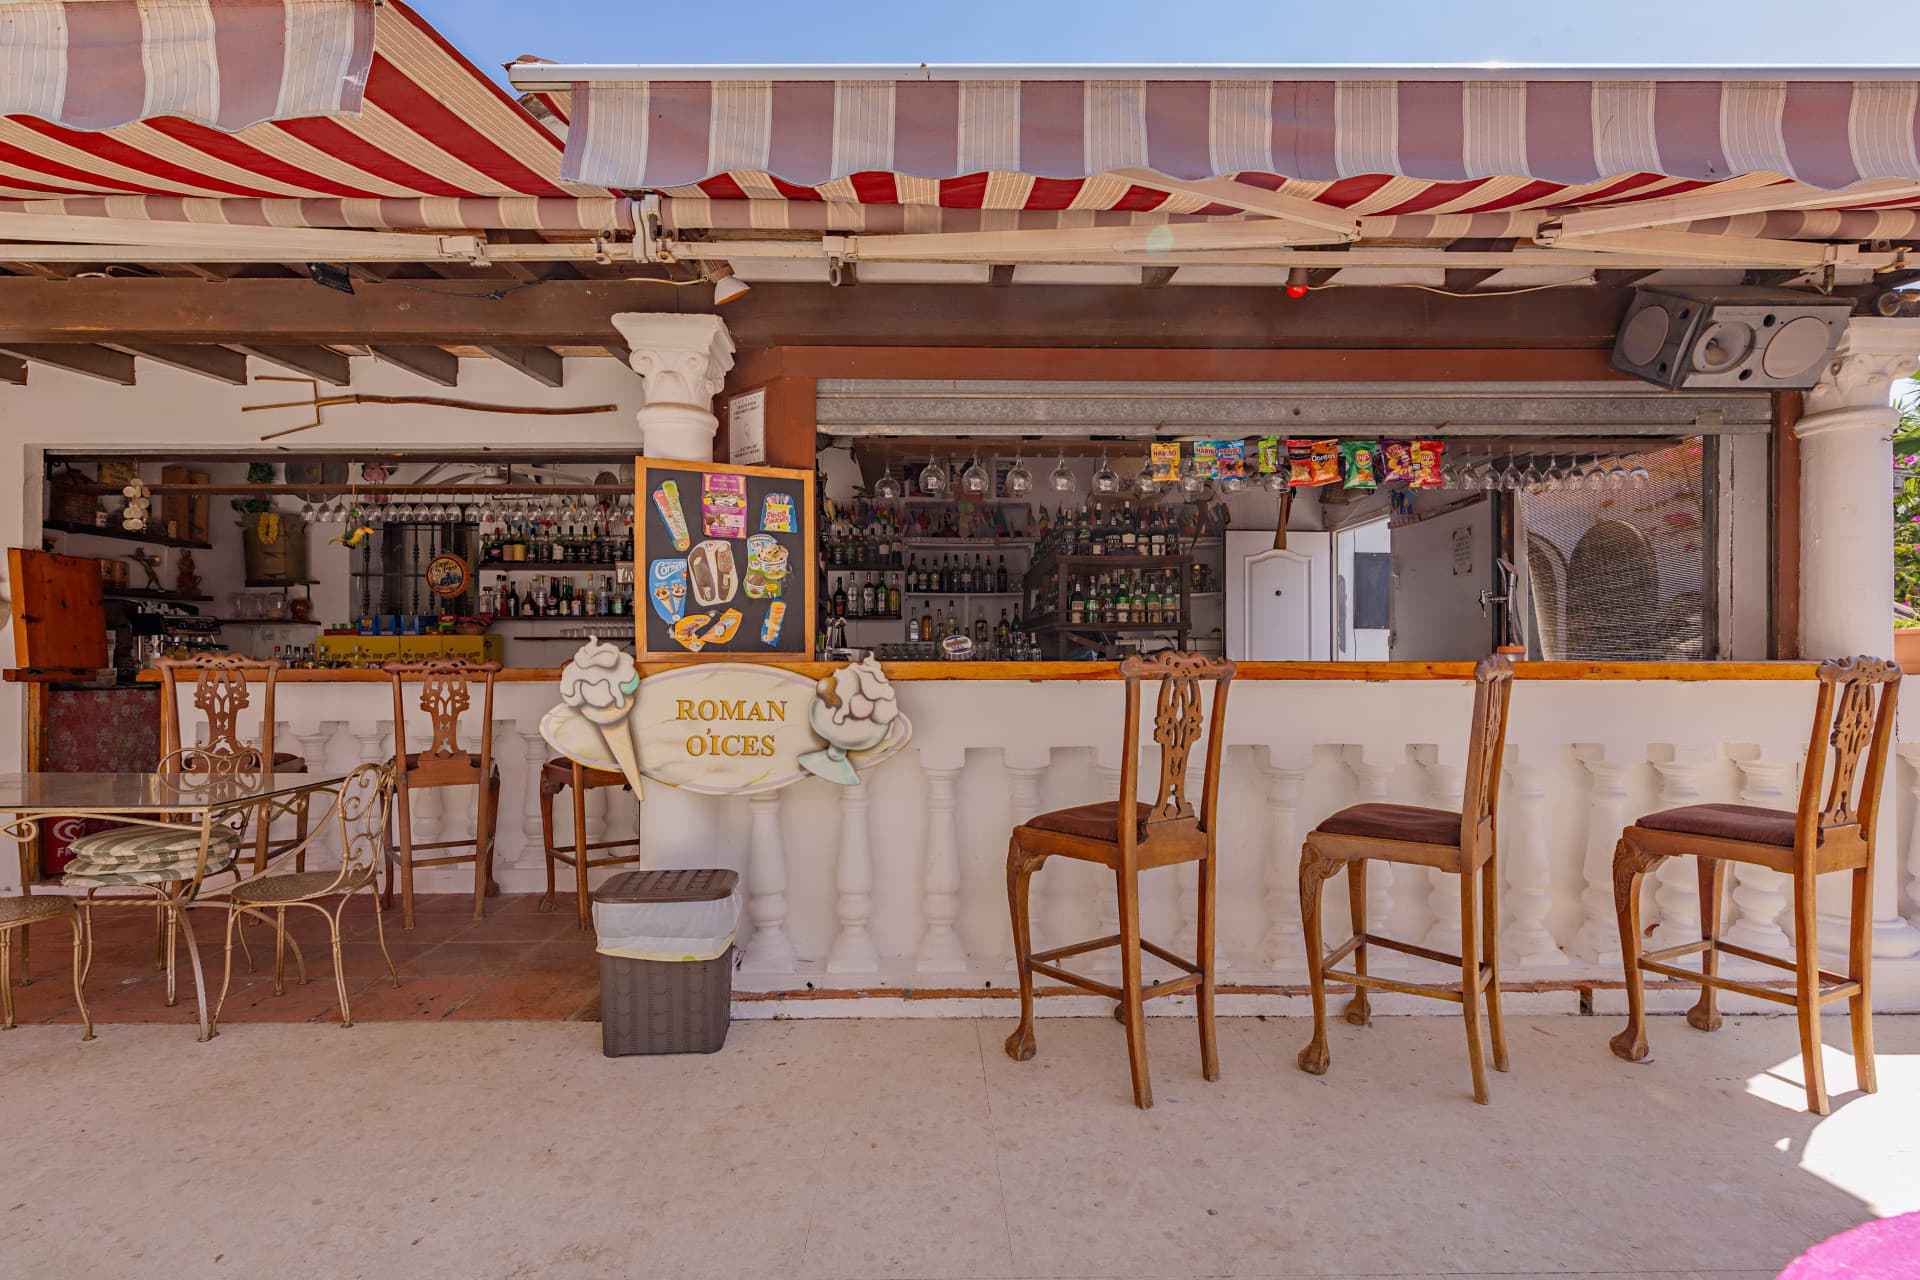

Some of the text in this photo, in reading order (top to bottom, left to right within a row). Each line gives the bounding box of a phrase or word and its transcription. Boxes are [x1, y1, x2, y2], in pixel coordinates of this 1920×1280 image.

[1311, 453, 1336, 463] Doritos
[675, 699, 788, 721] ROMAN
[686, 727, 776, 756] O'ICES
